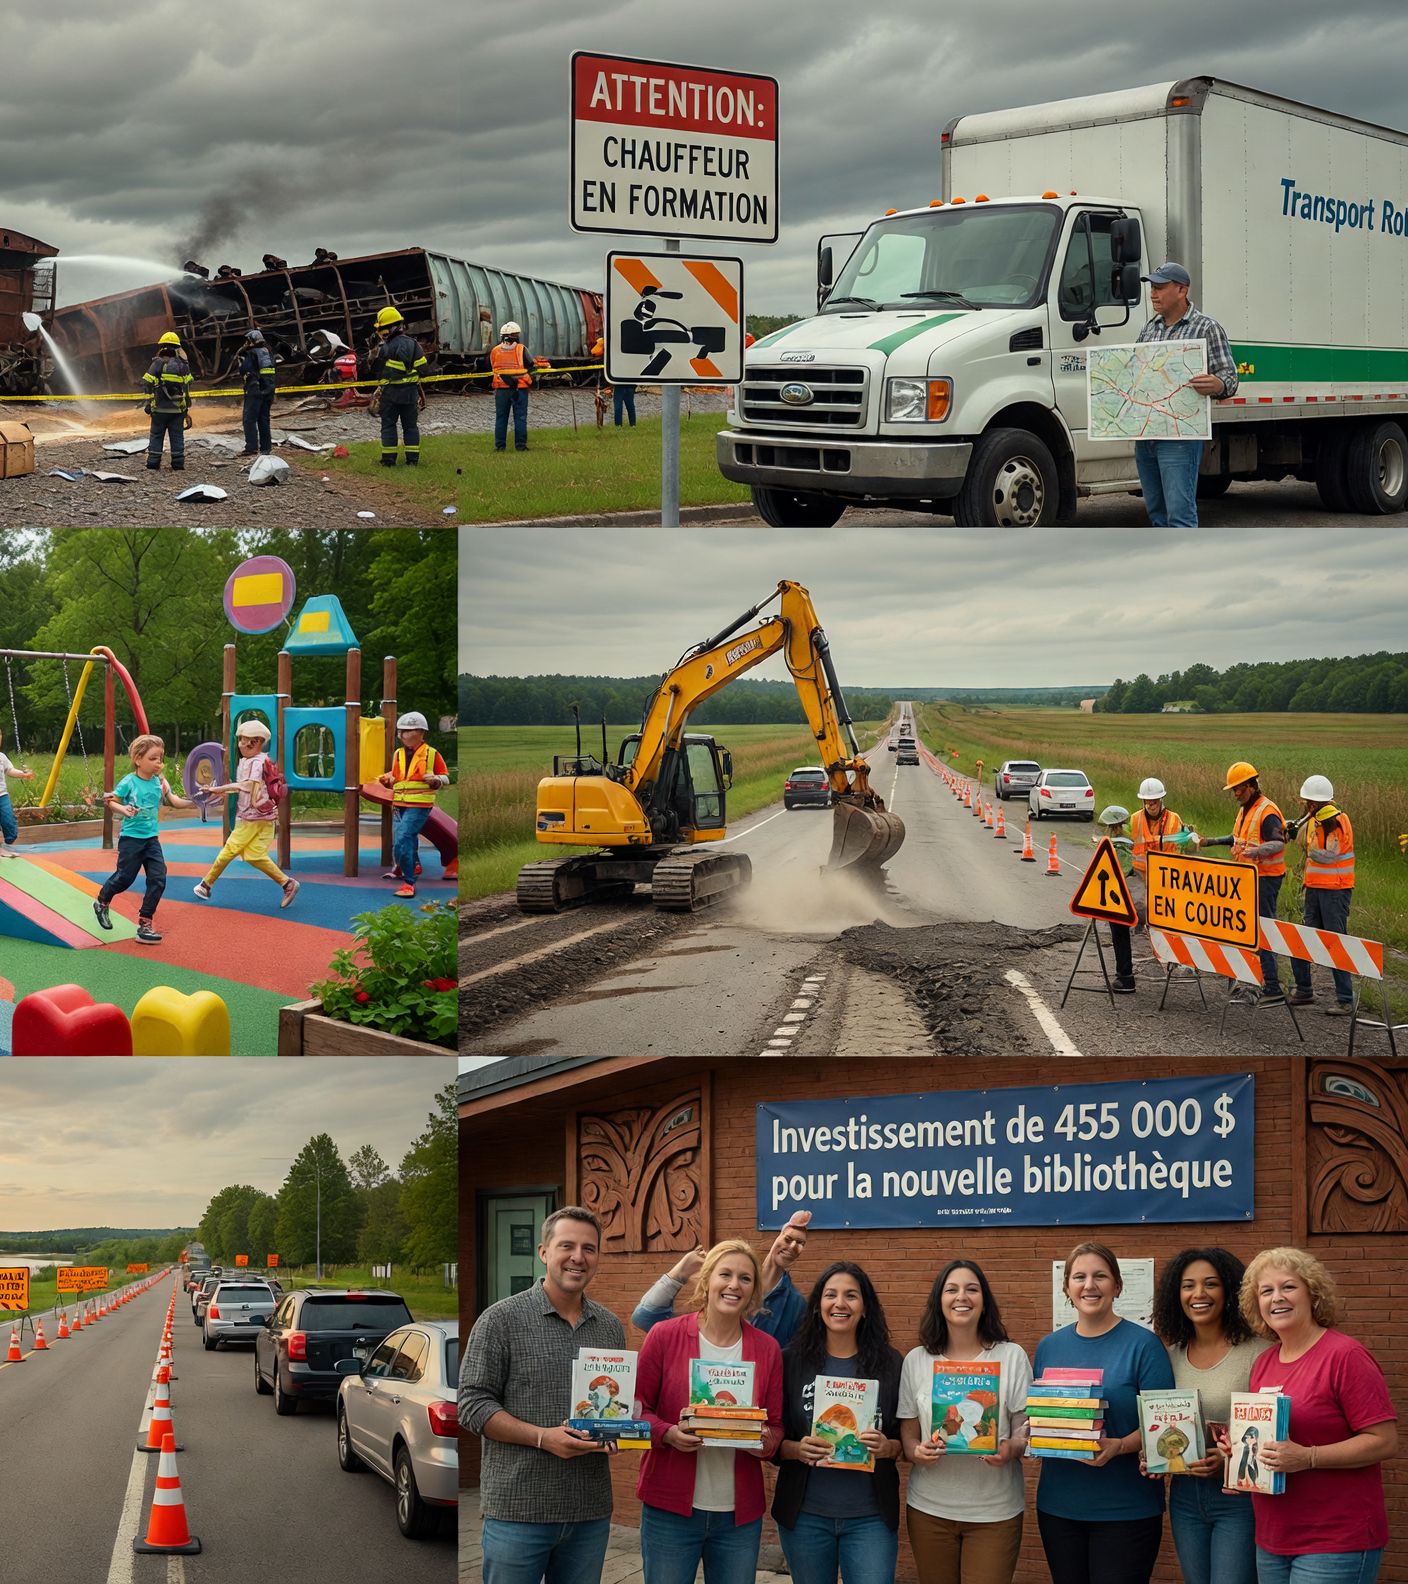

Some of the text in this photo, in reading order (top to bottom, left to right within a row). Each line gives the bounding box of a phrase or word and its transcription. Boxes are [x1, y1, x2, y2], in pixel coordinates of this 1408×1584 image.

[590, 71, 765, 128] ATTENTION:
[603, 135, 750, 180] CHAUFFEUR
[583, 180, 768, 225] EN FORMATION
[1280, 177, 1375, 233] Transport
[1159, 866, 1242, 901] TRAVAUX
[1154, 895, 1247, 933] EN COURS
[772, 1093, 1236, 1154] Investissement de 455 000 $
[772, 1150, 1233, 1211] pour la nouvelle bibliothèque
